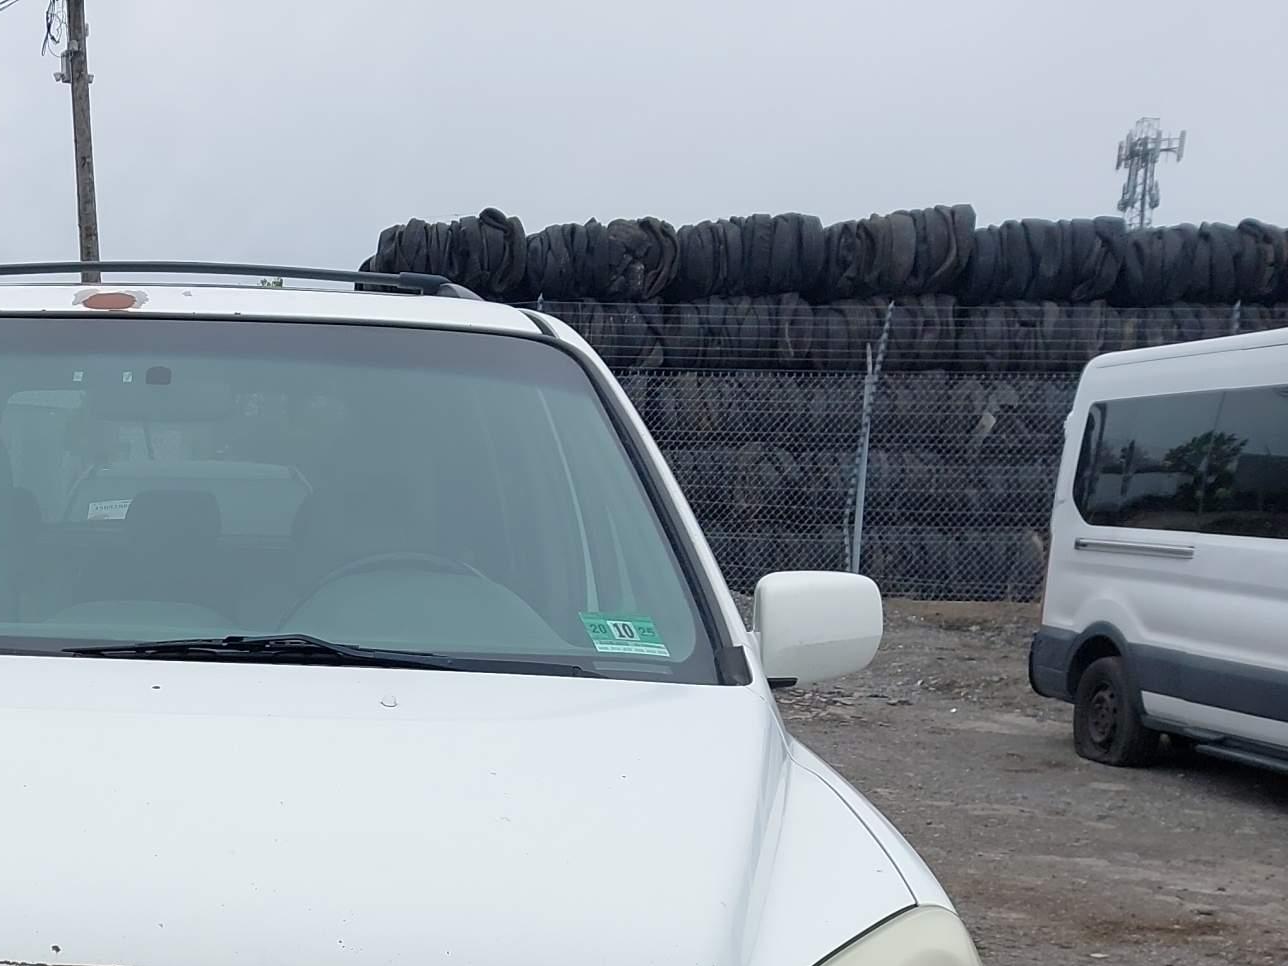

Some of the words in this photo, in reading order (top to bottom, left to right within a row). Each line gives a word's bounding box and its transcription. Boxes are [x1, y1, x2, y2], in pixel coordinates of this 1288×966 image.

[591, 623, 607, 634] 20
[613, 622, 635, 639] 10
[638, 626, 656, 637] 25
